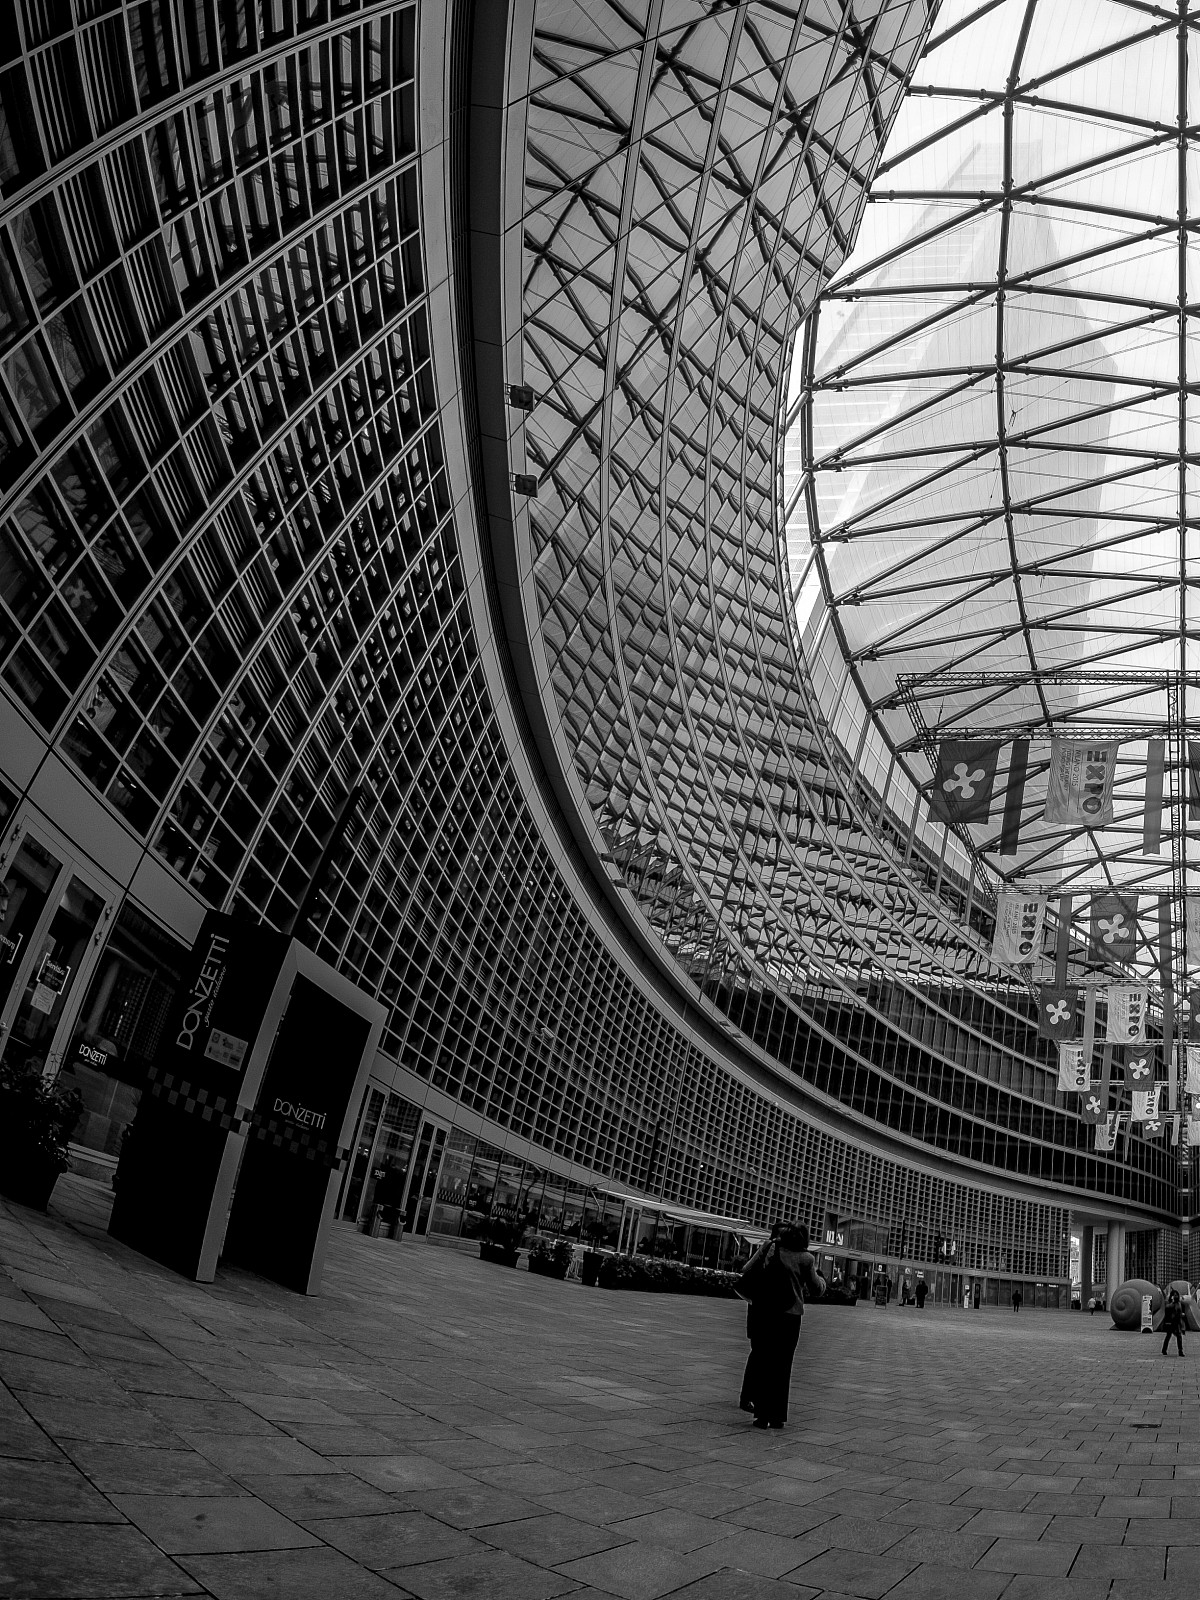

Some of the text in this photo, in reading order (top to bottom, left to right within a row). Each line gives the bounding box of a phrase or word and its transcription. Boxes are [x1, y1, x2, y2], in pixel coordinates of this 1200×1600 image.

[1082, 750, 1108, 815] EXPO
[1019, 903, 1038, 955] EXPO
[1128, 993, 1141, 1036] EXPO
